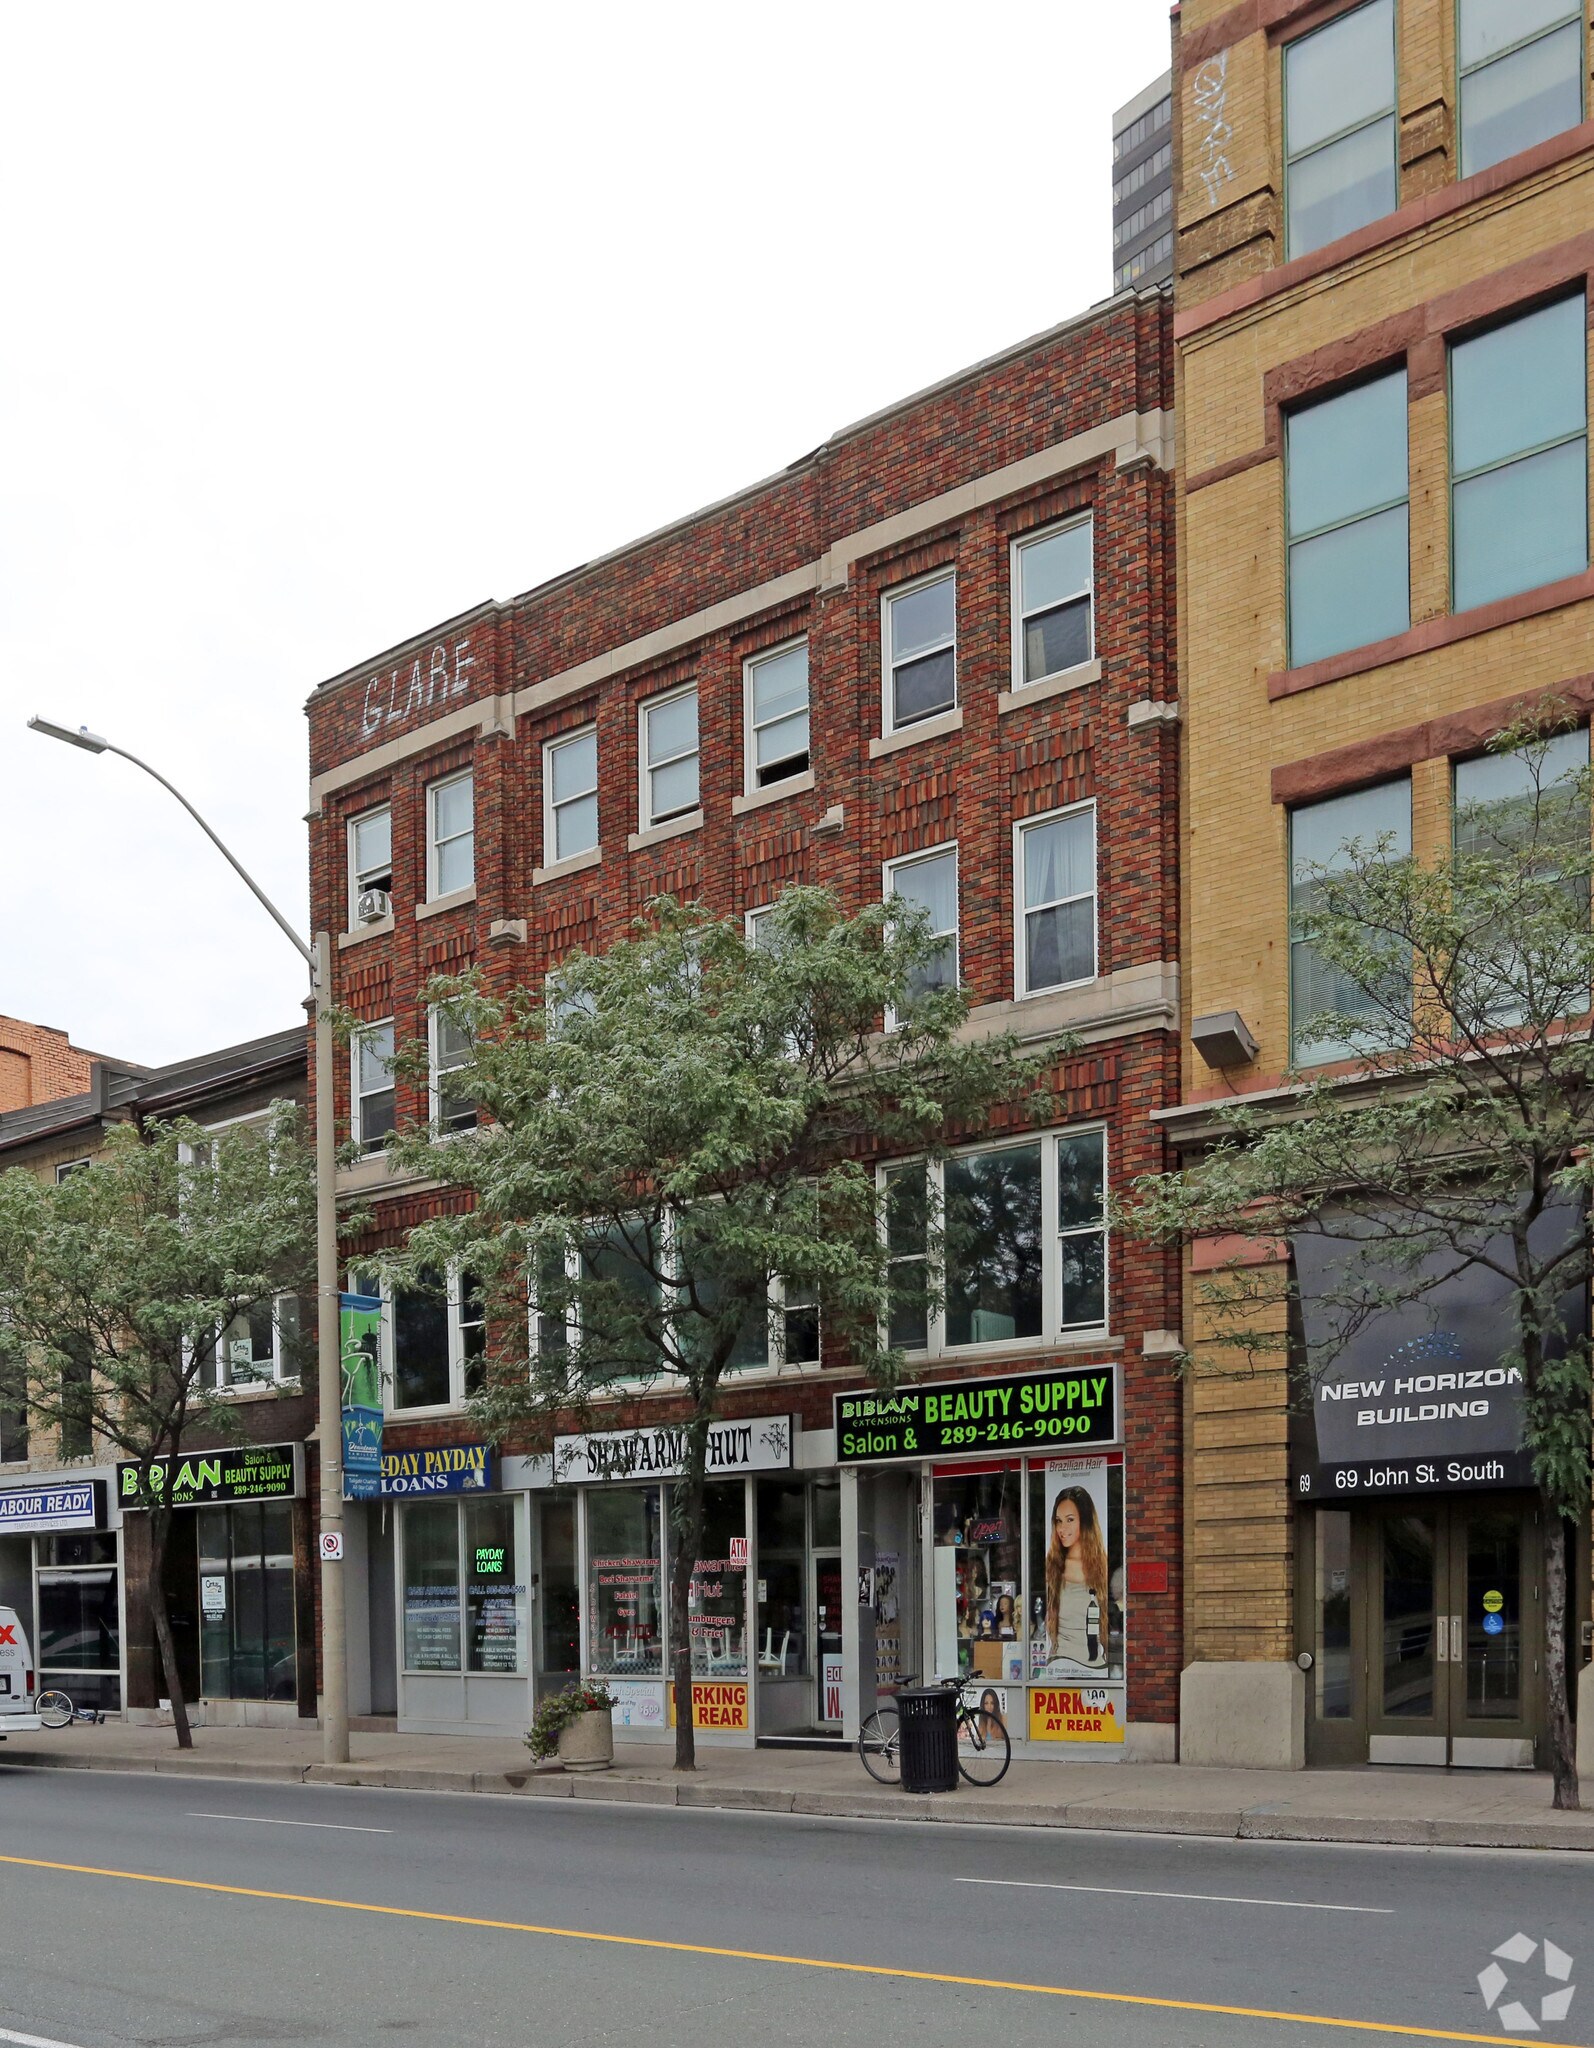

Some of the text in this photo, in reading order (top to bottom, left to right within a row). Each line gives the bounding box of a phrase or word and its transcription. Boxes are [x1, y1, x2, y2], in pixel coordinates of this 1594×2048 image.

[1321, 1380, 1385, 1401] NEW
[842, 1396, 919, 1418] BIBIAN
[925, 1377, 1107, 1423] BEAUTY SUPPLY
[852, 1414, 911, 1427] EXTENSIONS
[1357, 1400, 1489, 1426] BUILDING
[941, 1415, 1091, 1444] 289-246-9090
[587, 1424, 751, 1474] SHAWARM HUT
[843, 1427, 917, 1454] Salon &
[245, 1453, 272, 1466] Salon &
[424, 1447, 487, 1474] PAYDAY
[1049, 1458, 1103, 1472] Brazilian Hair
[225, 1464, 291, 1484] BEAUTY SUPPLY
[1335, 1461, 1504, 1489] 69 John St. South
[233, 1482, 286, 1495] 289-246-9090
[380, 1474, 448, 1493] LOANS
[1300, 1475, 1310, 1493] 69
[0, 1493, 90, 1516] ABOUR READY
[476, 1549, 505, 1560] PAYDAY
[731, 1539, 748, 1558] ATM
[476, 1561, 502, 1573] LOANS
[592, 1558, 660, 1567] Chicken Shawarma
[693, 1560, 744, 1573] awarma
[599, 1575, 653, 1583] Beef Shawarma
[614, 1591, 638, 1599] Falafel
[695, 1581, 722, 1598] Hut
[617, 1608, 636, 1617] Gyro
[688, 1614, 735, 1627] amburgers
[691, 1627, 724, 1637] & Fries
[0, 1649, 15, 1657] ess
[625, 1686, 655, 1697] Special
[673, 1686, 746, 1705] RKING
[698, 1707, 743, 1725] REAR
[1046, 1719, 1102, 1731] AT REAR
